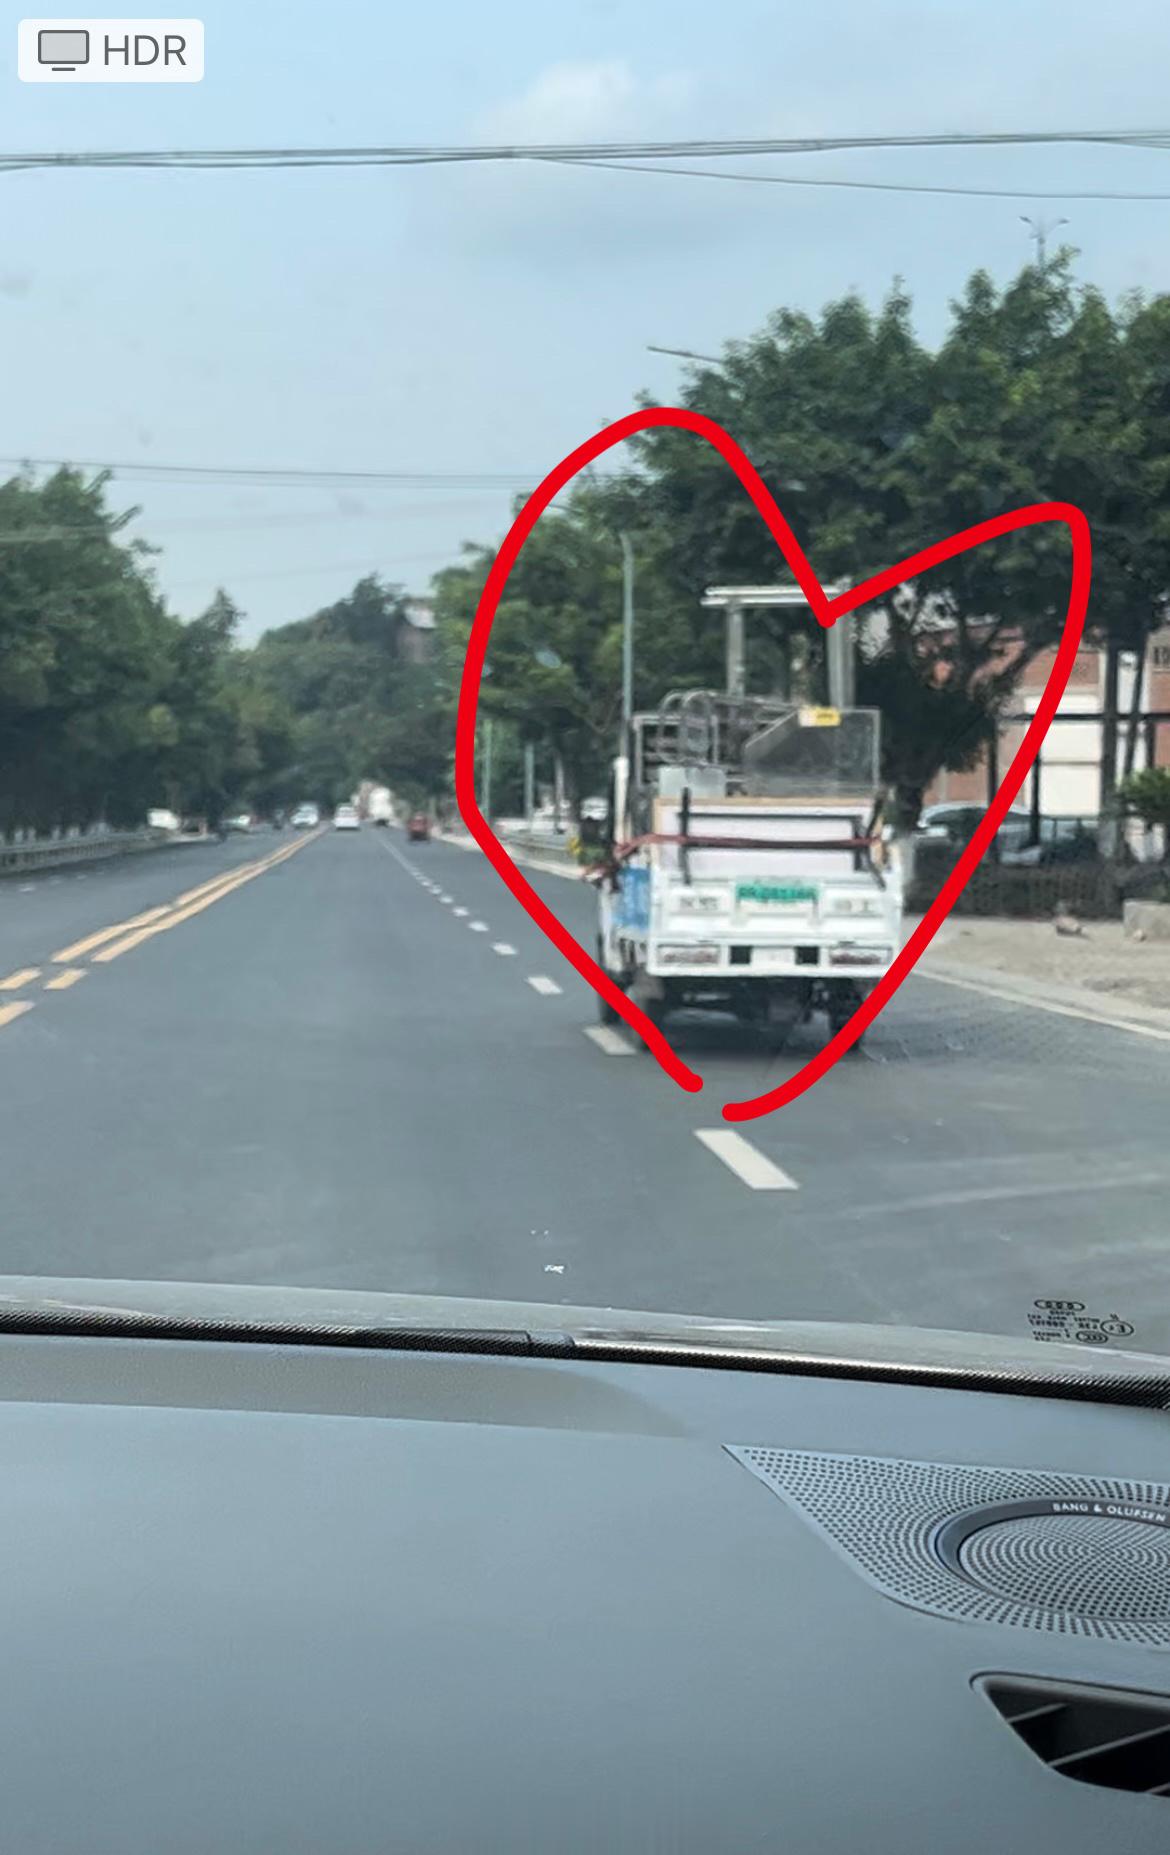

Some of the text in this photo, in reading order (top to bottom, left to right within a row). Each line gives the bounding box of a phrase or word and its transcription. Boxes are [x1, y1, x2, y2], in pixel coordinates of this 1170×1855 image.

[1052, 1502, 1167, 1522] BANG & OLUFSEN
